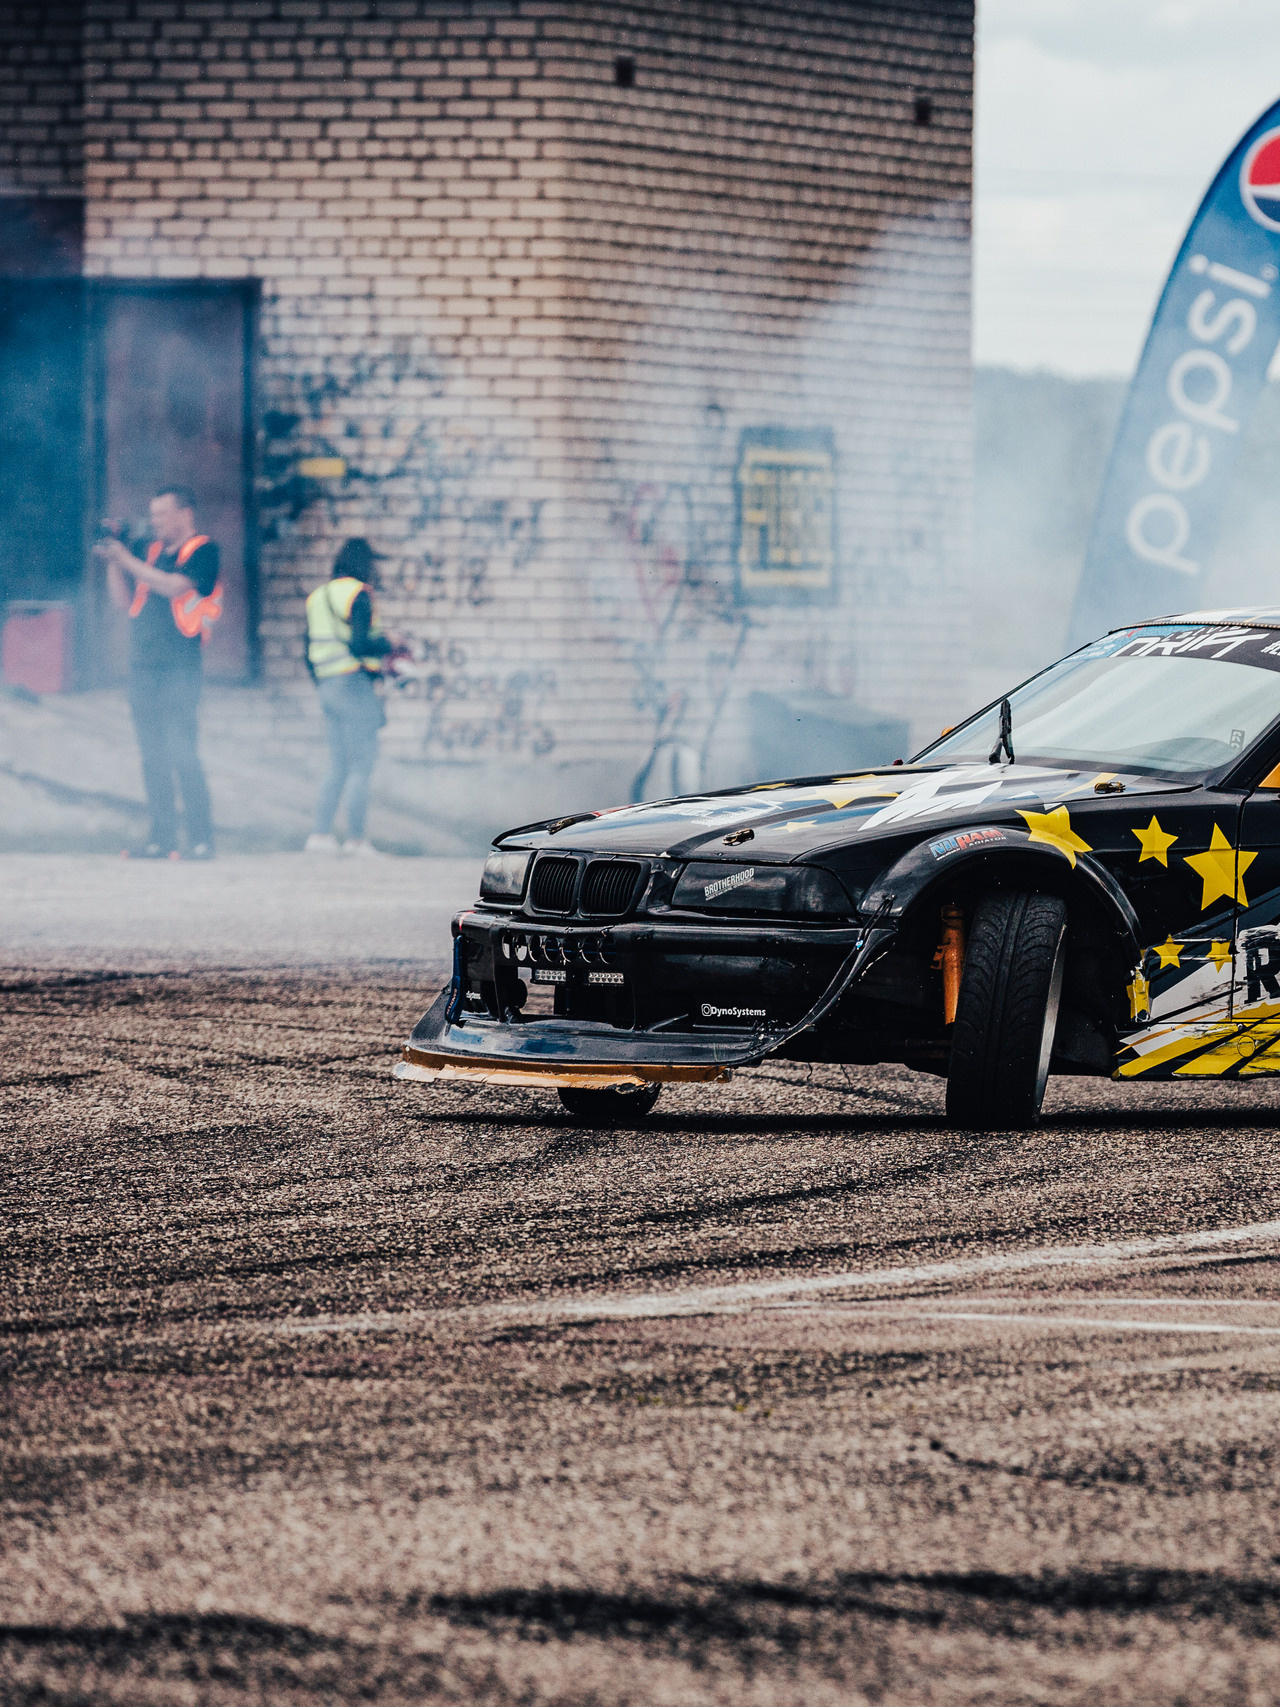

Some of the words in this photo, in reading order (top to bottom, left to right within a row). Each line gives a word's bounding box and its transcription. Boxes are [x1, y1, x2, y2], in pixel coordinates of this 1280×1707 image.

[1125, 254, 1274, 574] pepsi
[704, 867, 755, 897] BROTHERHOOD
[711, 1006, 767, 1018] DynoSystems
